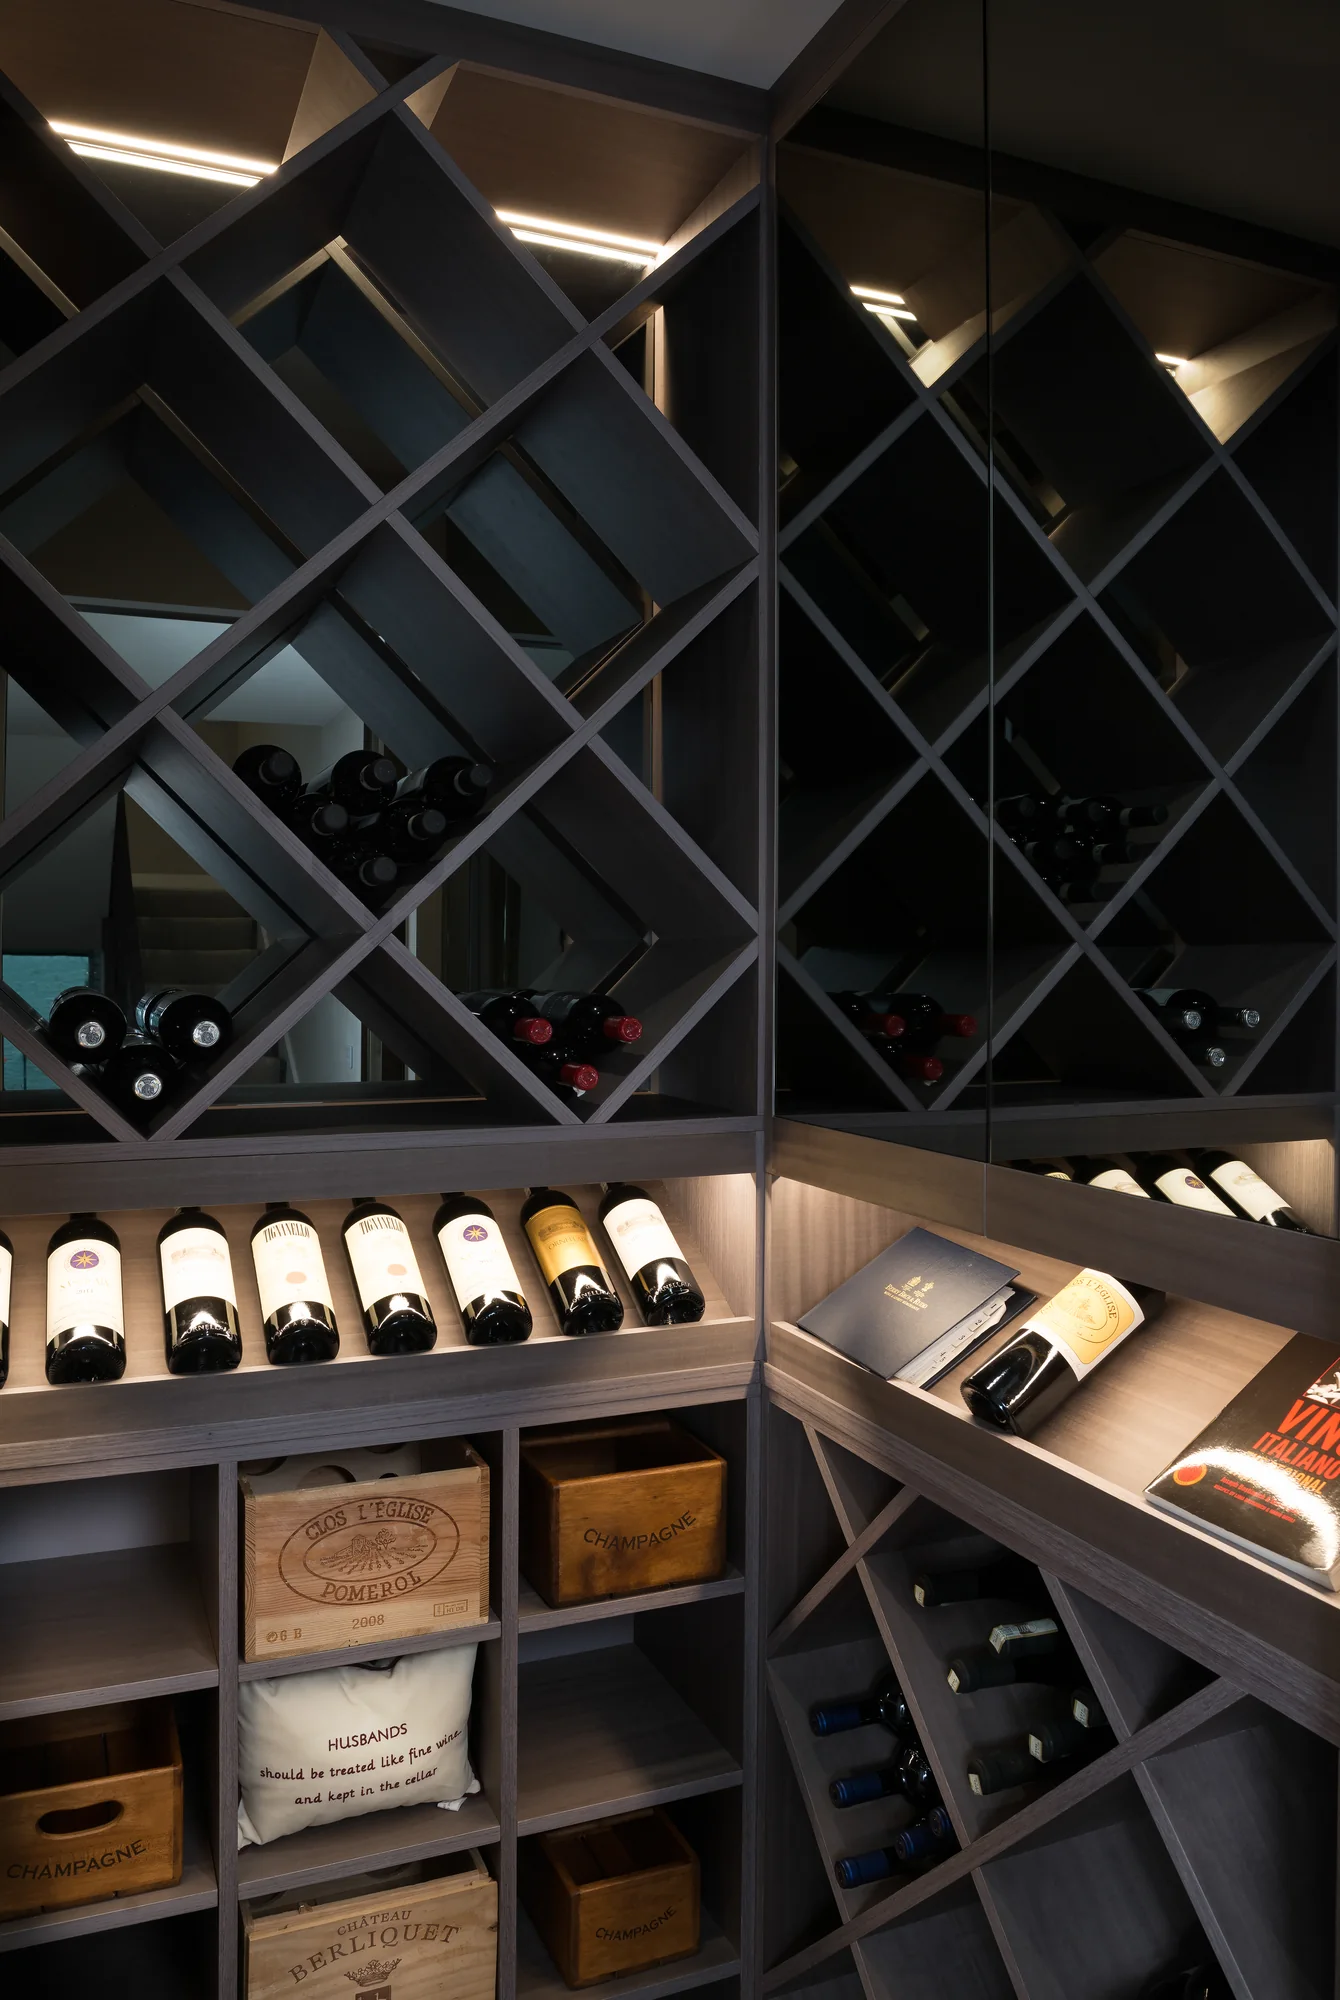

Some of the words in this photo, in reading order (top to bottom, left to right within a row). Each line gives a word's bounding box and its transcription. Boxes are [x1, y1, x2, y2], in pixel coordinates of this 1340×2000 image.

[1277, 1399, 1340, 1456] VIN
[1252, 1431, 1340, 1479] ITALIANO
[305, 1510, 348, 1541] CLOS
[583, 1509, 697, 1551] CHAMPAGNE
[320, 1569, 422, 1602] POMEROL
[351, 1614, 385, 1630] 2008
[259, 1767, 305, 1781] should
[310, 1767, 325, 1779] be
[329, 1758, 376, 1777] treated
[381, 1753, 405, 1769] like
[408, 1744, 433, 1765] fine
[435, 1728, 463, 1750] wine
[327, 1722, 409, 1752] HUSBANDS
[294, 1792, 322, 1805] and
[327, 1788, 356, 1803] kept
[360, 1785, 375, 1797] in
[379, 1780, 400, 1792] the
[405, 1766, 438, 1786] cellar
[6, 1839, 147, 1880] CHAMPAGNE
[336, 1909, 413, 1936] CHÂTEAU
[595, 1905, 678, 1941] CHAMPAGNE
[287, 1923, 462, 1985] BERLIQUET
